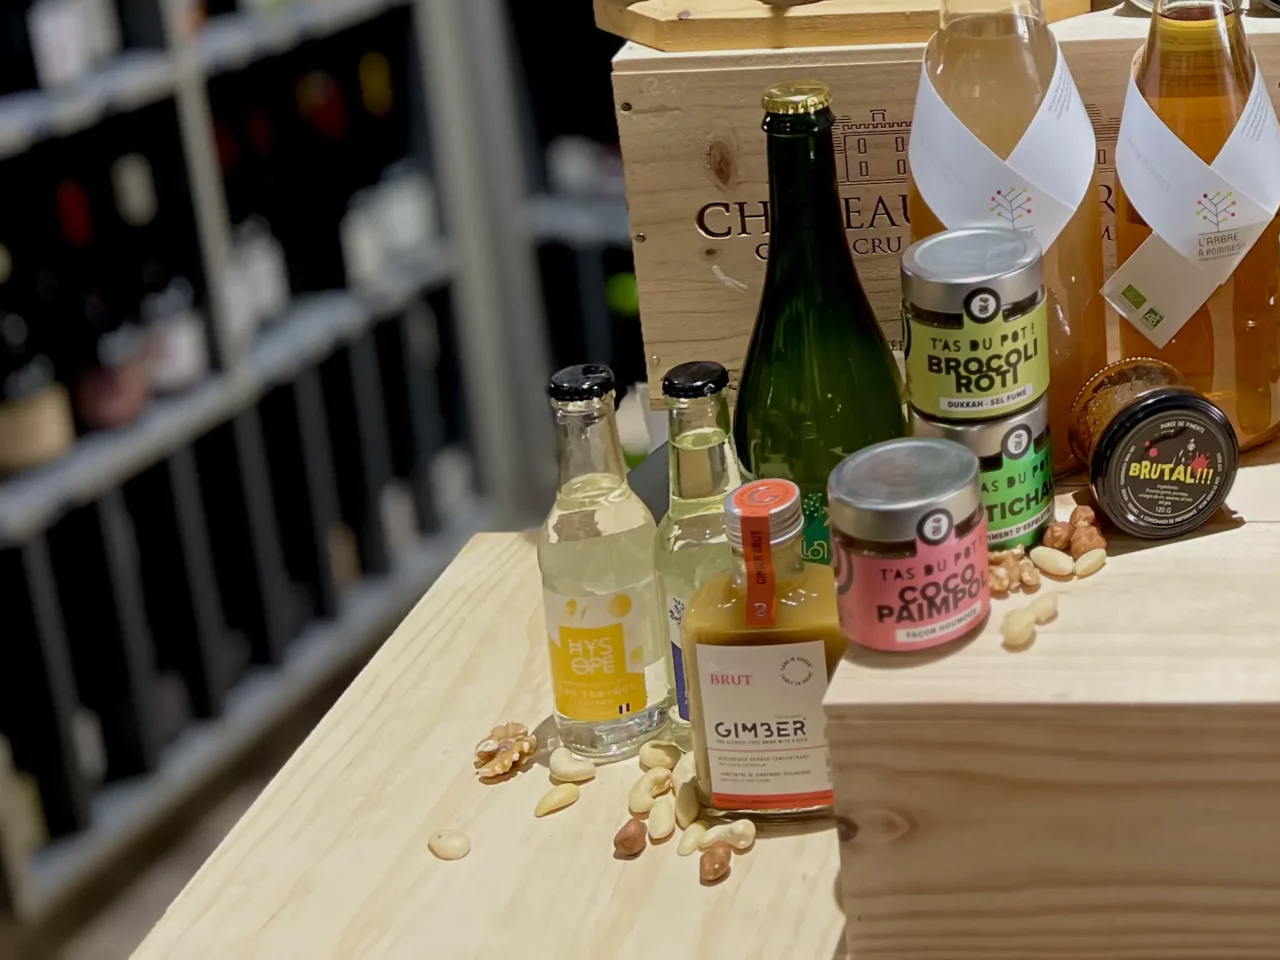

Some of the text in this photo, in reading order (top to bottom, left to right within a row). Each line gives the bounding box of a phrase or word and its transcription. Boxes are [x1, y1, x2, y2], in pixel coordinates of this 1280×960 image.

[853, 236, 902, 255] CRU
[1198, 232, 1240, 247] L'ARBRE
[1206, 243, 1241, 256] POMMES
[930, 337, 992, 352] T'AS DU
[927, 338, 1038, 376] BROCOLI
[948, 388, 1027, 409] DUKKAH SEL FUMÉ
[1007, 472, 1027, 489] DU
[1129, 460, 1214, 485] BRUTAL!!!
[880, 558, 947, 582] T'AS DU
[898, 563, 976, 605] COCO
[876, 575, 987, 624] PAIMPOL
[906, 608, 978, 640] FAÇON HOUMOUS
[568, 637, 613, 656] HYS
[571, 655, 615, 676] OPE
[710, 673, 752, 686] BRUT
